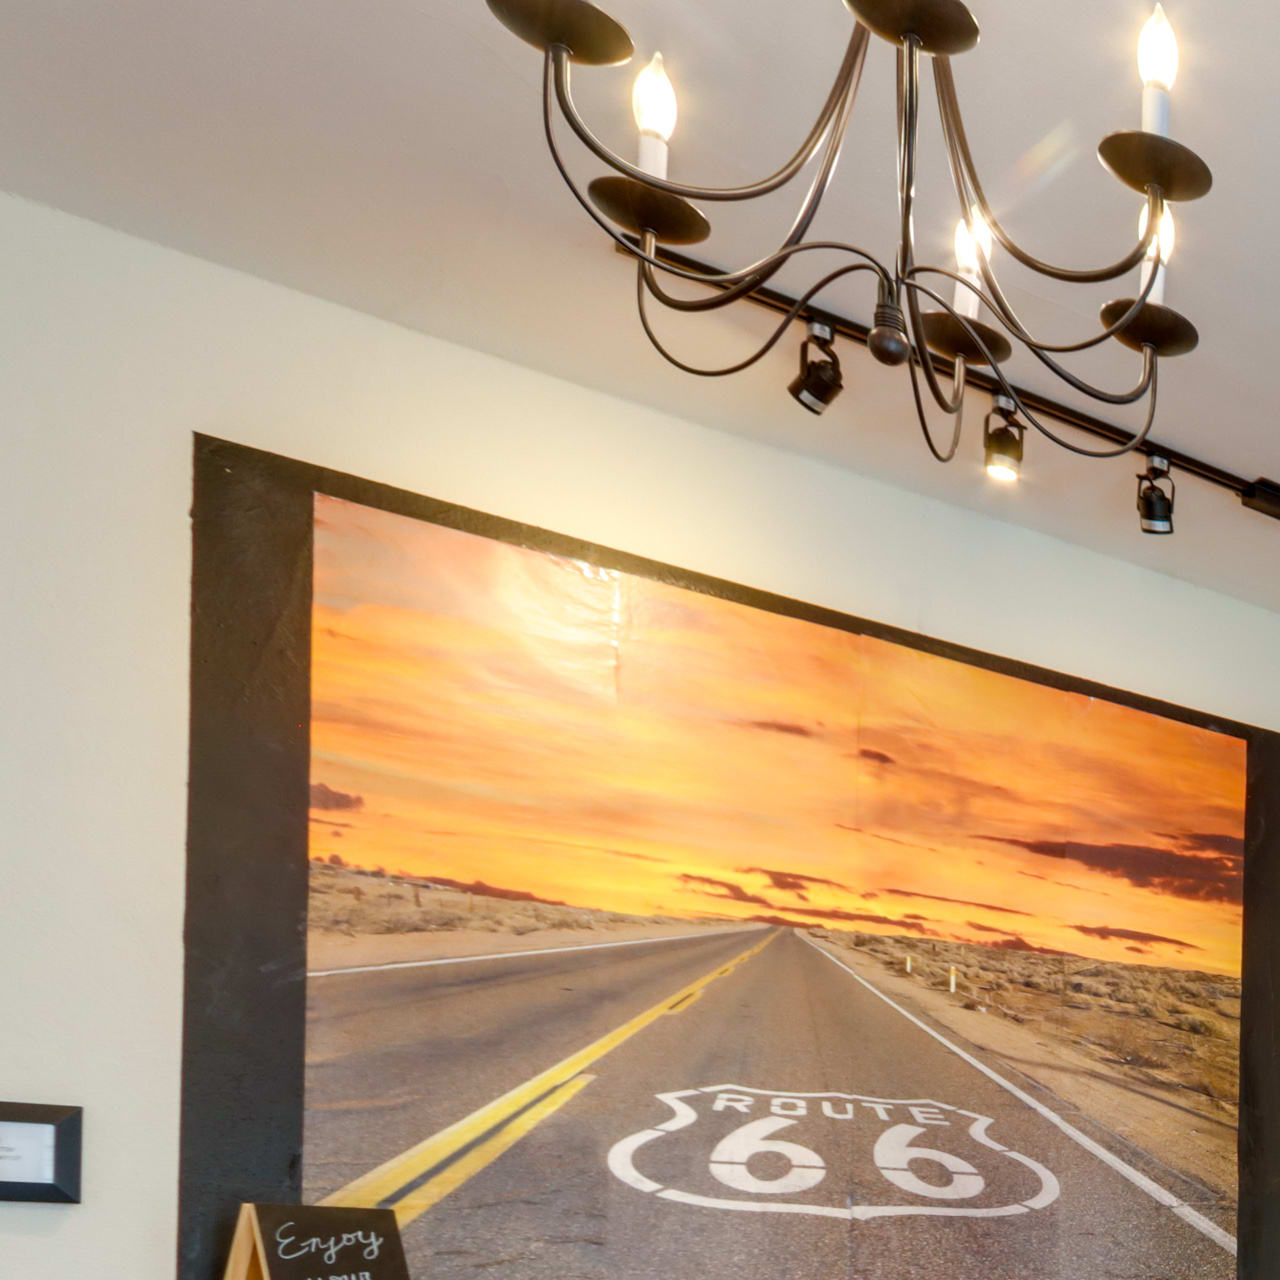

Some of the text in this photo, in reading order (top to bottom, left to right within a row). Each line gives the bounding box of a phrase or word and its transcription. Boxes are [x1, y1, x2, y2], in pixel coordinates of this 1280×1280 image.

[711, 1092, 952, 1126] ROUTE
[708, 1115, 986, 1200] 66
[275, 1221, 385, 1264] Enjoy
